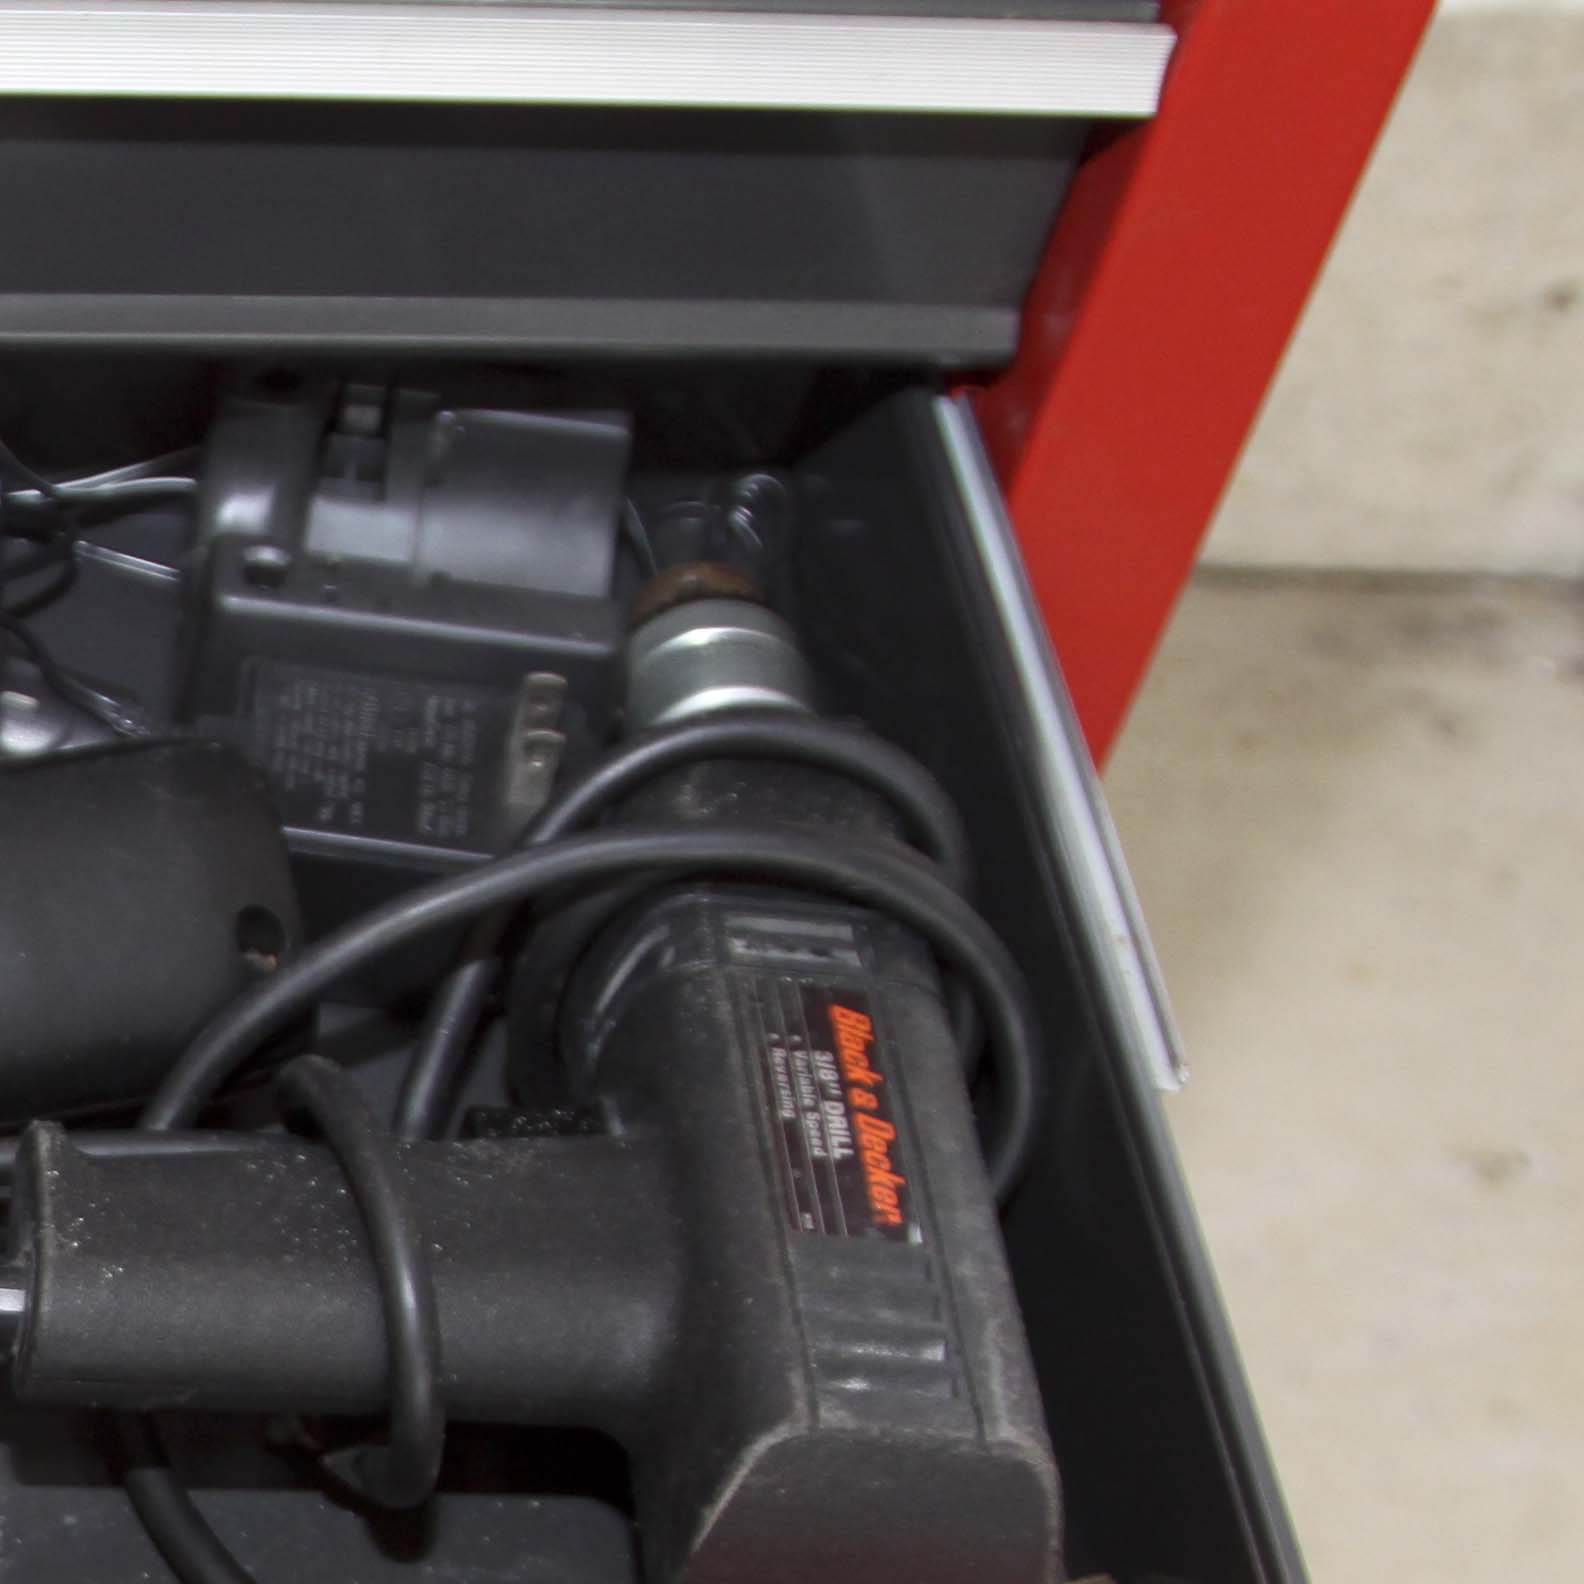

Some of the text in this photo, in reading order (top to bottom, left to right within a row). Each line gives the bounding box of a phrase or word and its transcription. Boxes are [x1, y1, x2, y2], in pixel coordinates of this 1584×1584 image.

[771, 1047, 797, 1120] Reversing
[828, 1003, 884, 1086] Black
[794, 1050, 828, 1160] Variable Speed
[825, 1100, 855, 1161] DRILL
[853, 1111, 906, 1226] Decker
